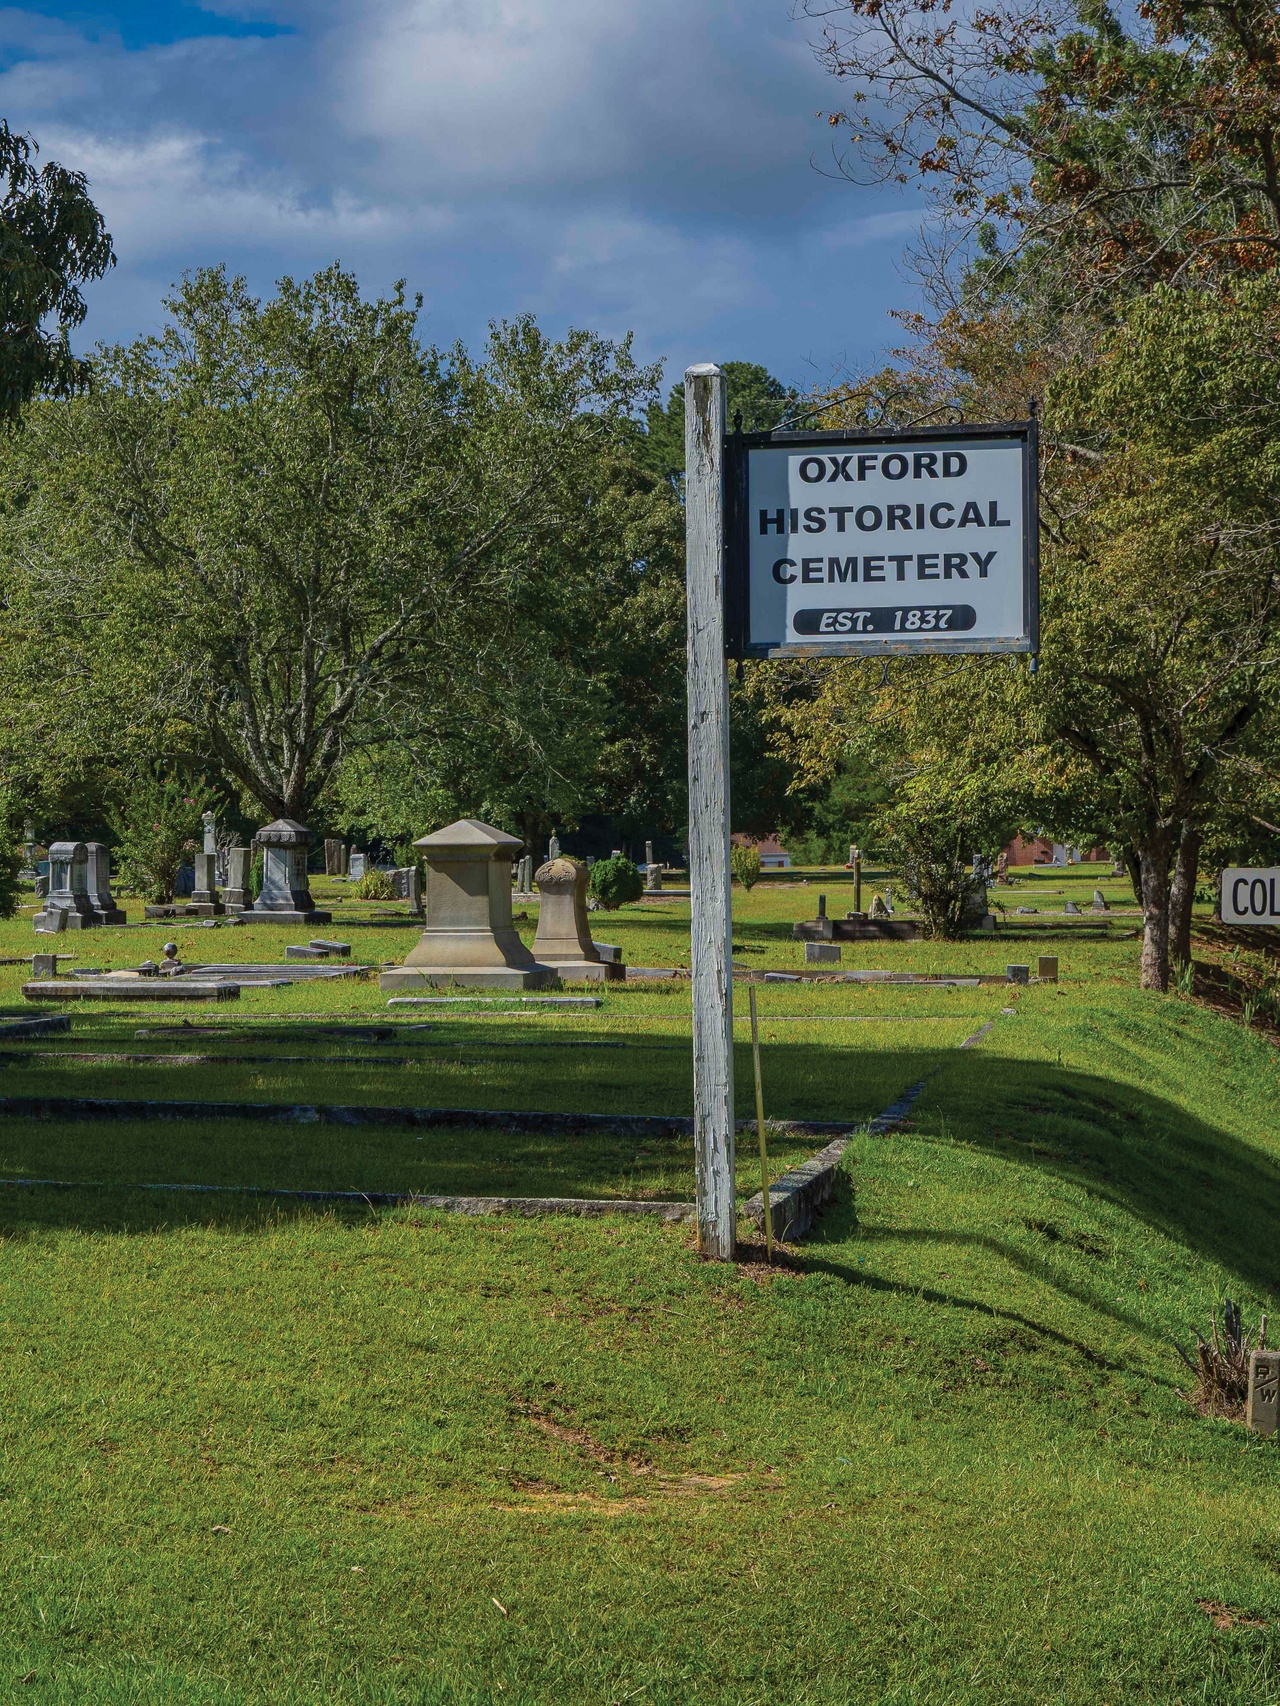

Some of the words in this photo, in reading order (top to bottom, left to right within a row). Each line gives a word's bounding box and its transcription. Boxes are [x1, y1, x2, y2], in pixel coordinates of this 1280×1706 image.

[798, 451, 968, 483] OXFORD
[759, 500, 1011, 536] HISTORICAL
[771, 551, 998, 585] CEMETERY
[819, 611, 874, 632] EST.
[893, 609, 953, 631] 1837
[1233, 878, 1280, 916] COL
